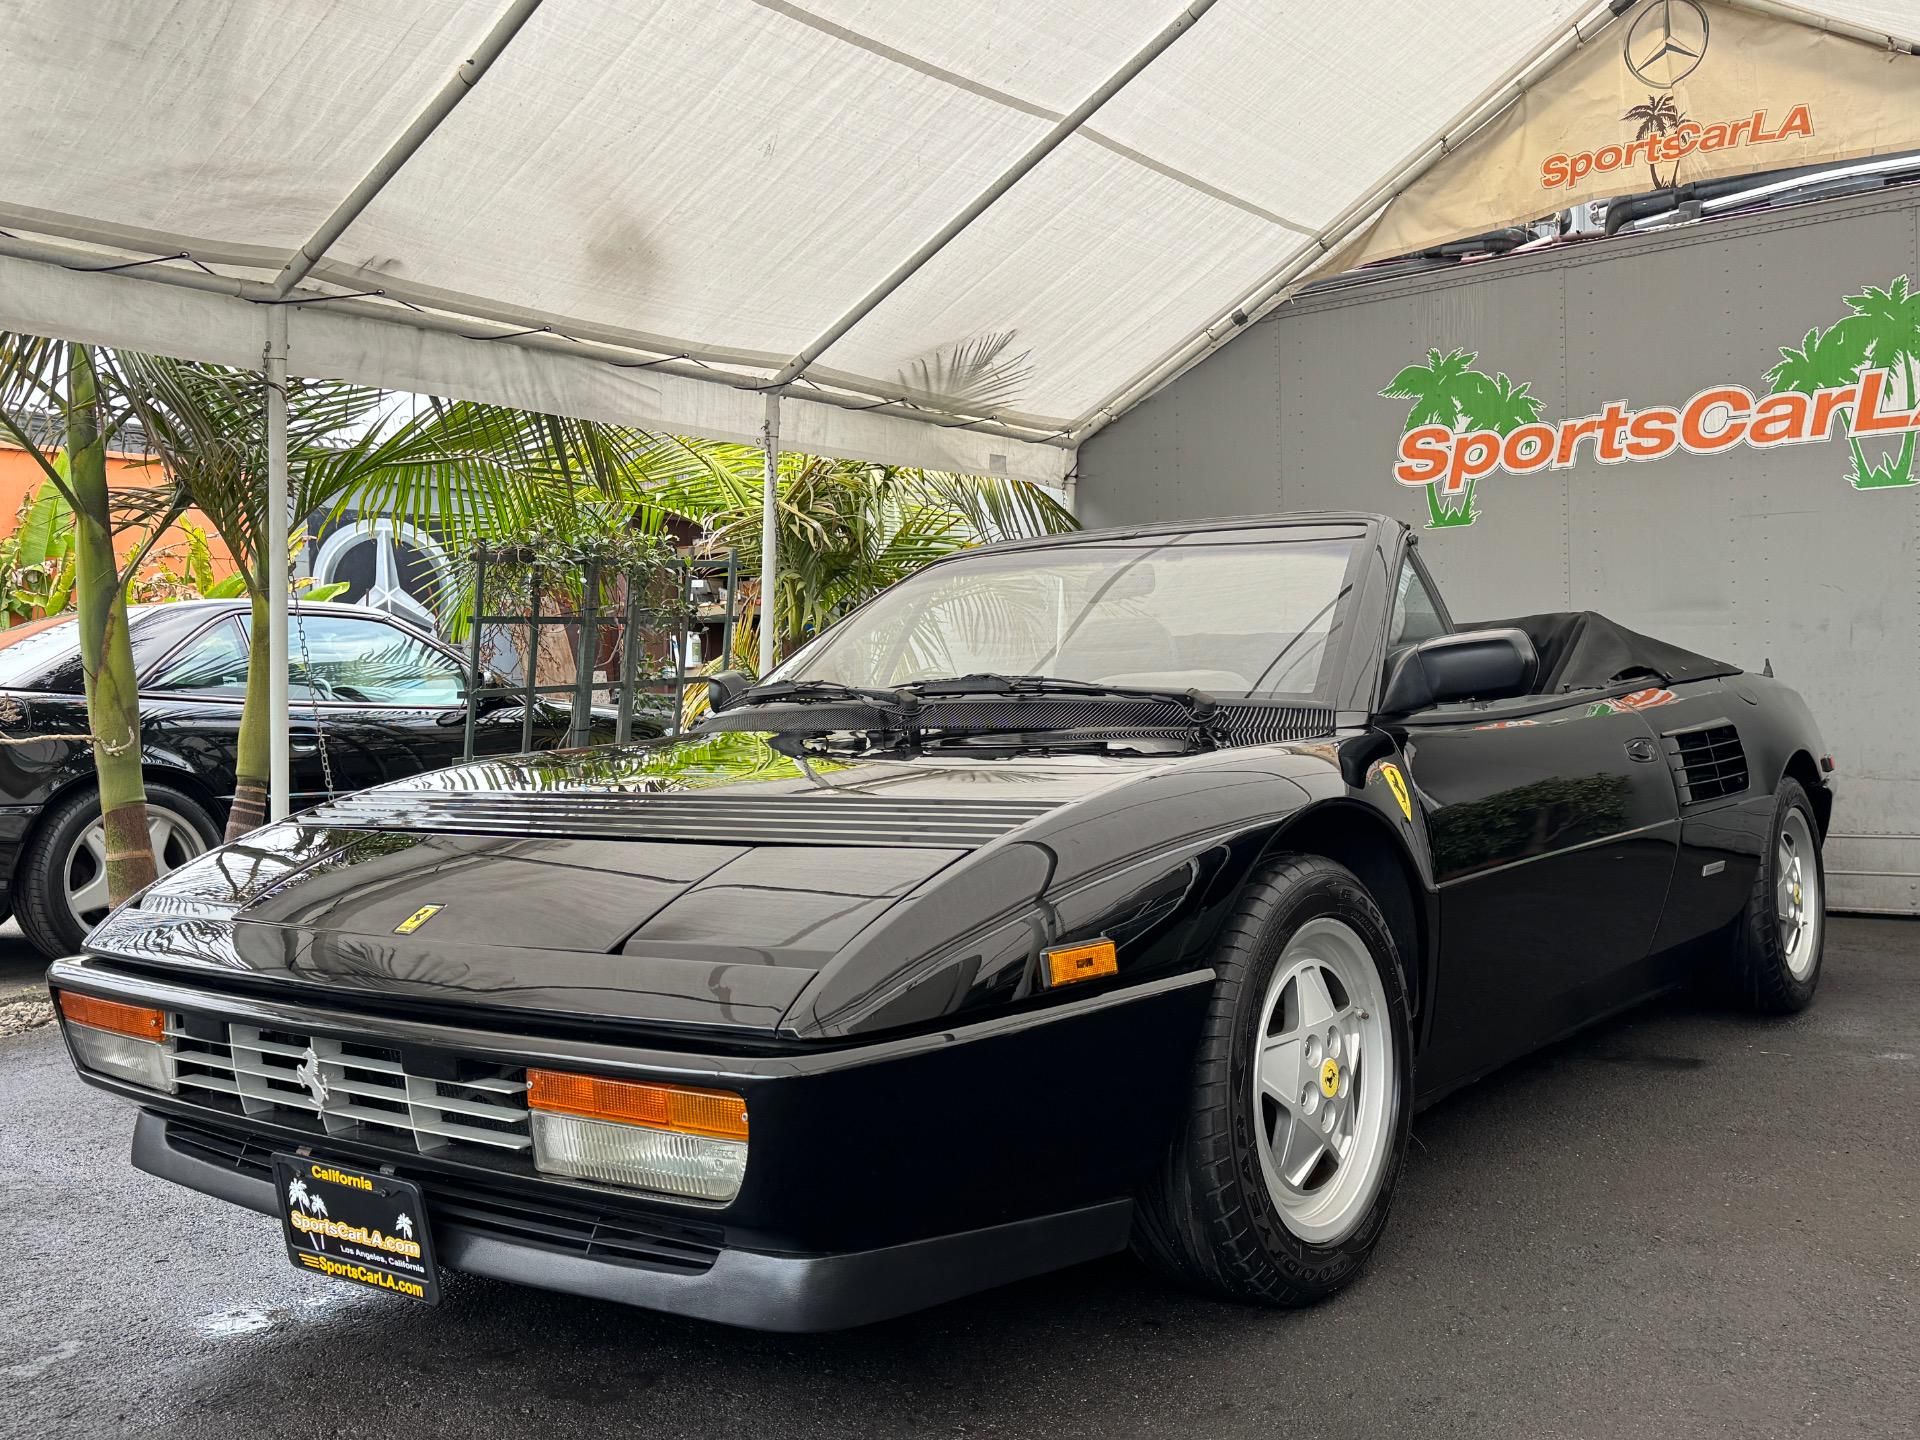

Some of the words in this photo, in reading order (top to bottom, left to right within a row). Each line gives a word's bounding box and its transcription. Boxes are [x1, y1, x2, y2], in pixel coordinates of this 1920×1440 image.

[1540, 104, 1813, 188] SportsCarLA
[1395, 368, 1920, 494] SportsCarL
[311, 1165, 373, 1191] California
[291, 1210, 421, 1258] SportsCarLA.com
[319, 1256, 424, 1298] SportsCarLA.com
[340, 1245, 354, 1255] Los
[355, 1248, 387, 1265] Angeles,
[388, 1257, 425, 1273] California
